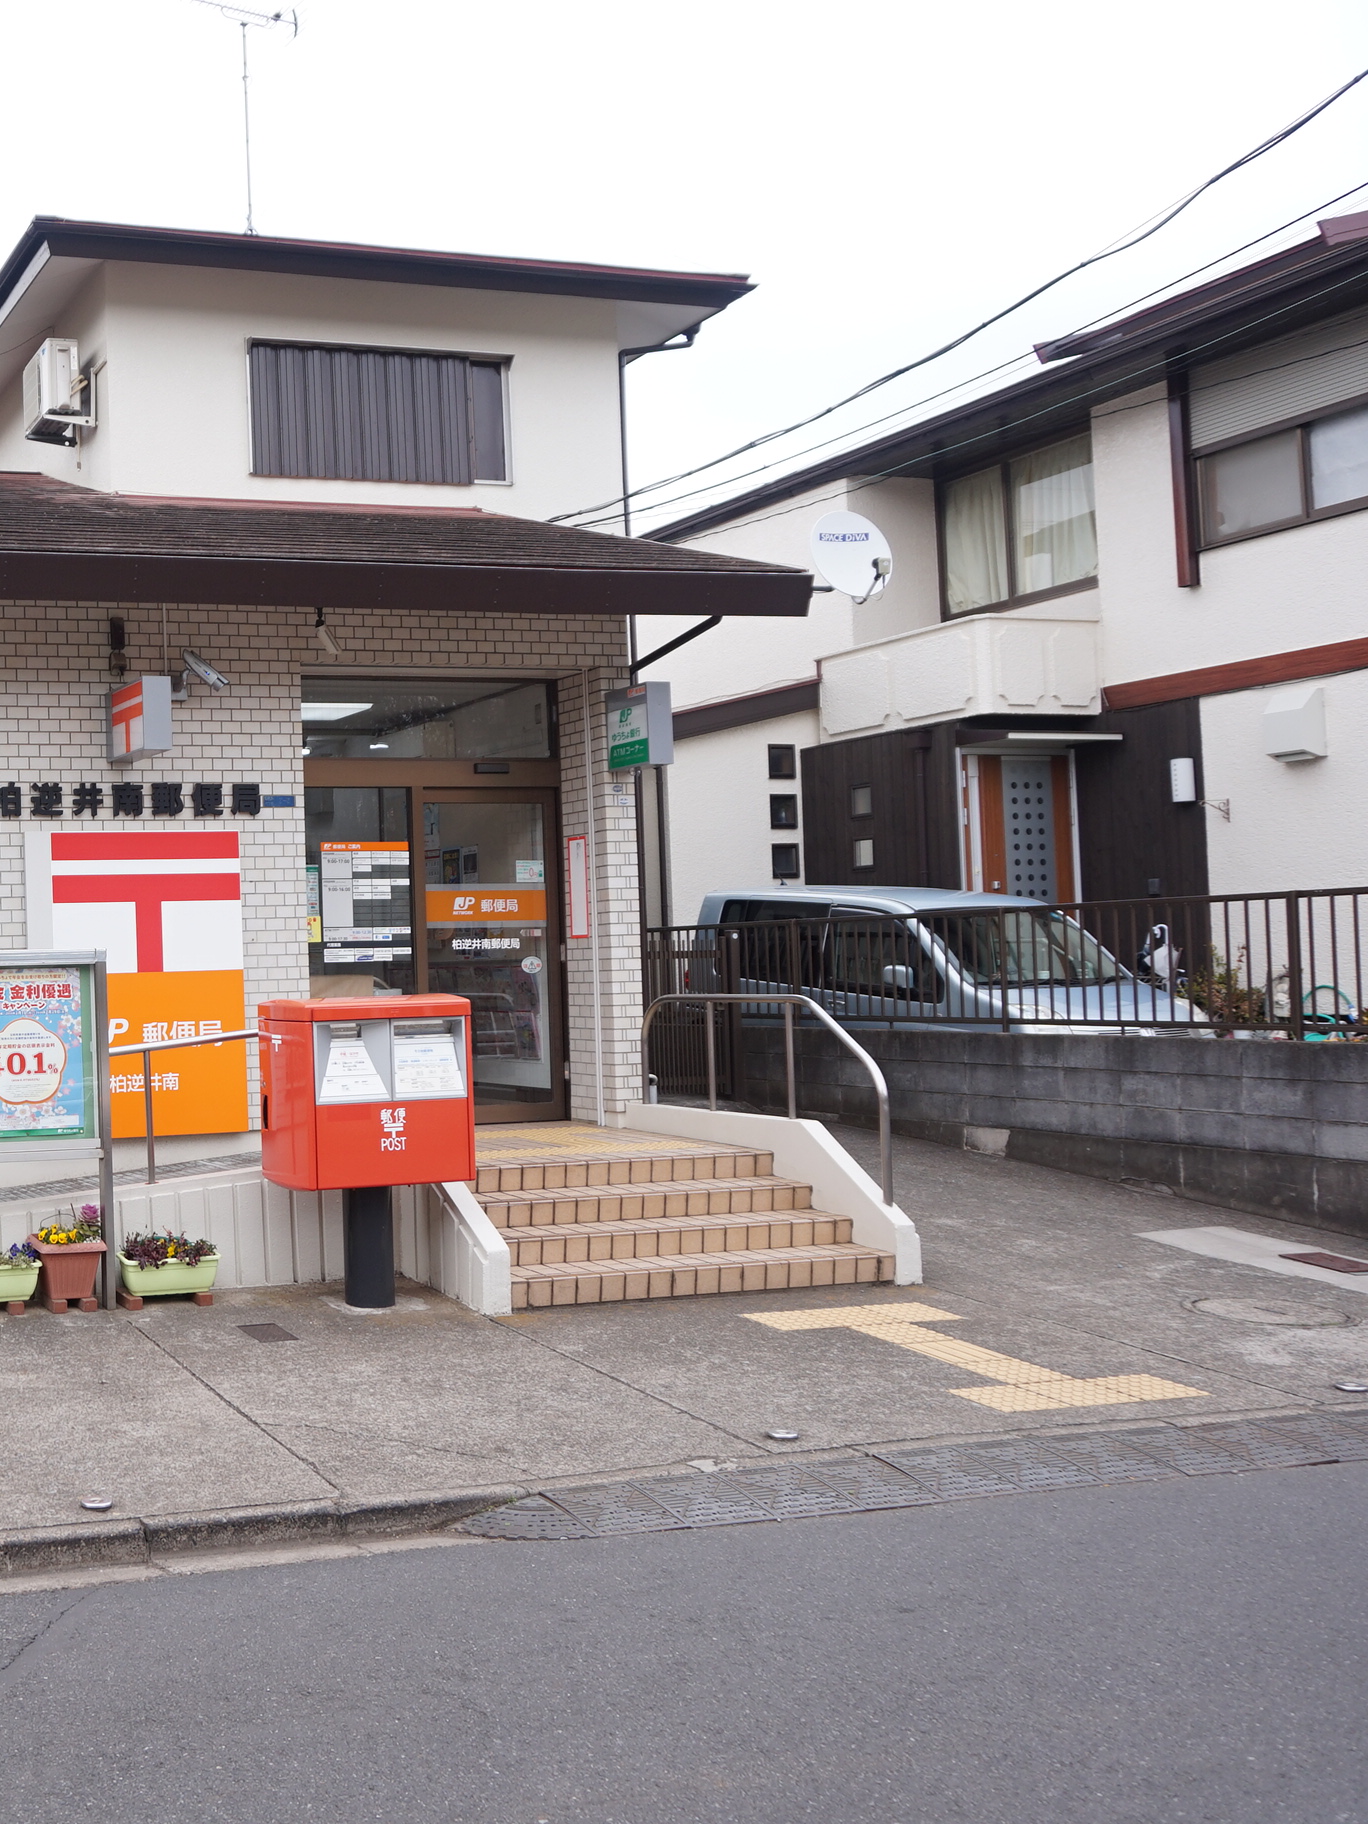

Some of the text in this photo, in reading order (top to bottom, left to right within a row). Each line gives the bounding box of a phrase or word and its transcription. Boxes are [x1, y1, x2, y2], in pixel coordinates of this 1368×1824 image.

[821, 533, 843, 541] SPACE
[620, 708, 632, 723] JP
[612, 727, 640, 742] ゆうちょ銀行
[453, 896, 518, 912] JP 郵便局
[452, 938, 520, 950] 柏逆井南郵便局
[10, 983, 72, 1000] 金利優遇
[2, 1001, 45, 1010] キャンペーン
[109, 1018, 223, 1047] P 郵便局
[109, 1072, 179, 1093] 柏逆井南
[380, 1108, 406, 1124] 郵便
[381, 1137, 406, 1151] POST
